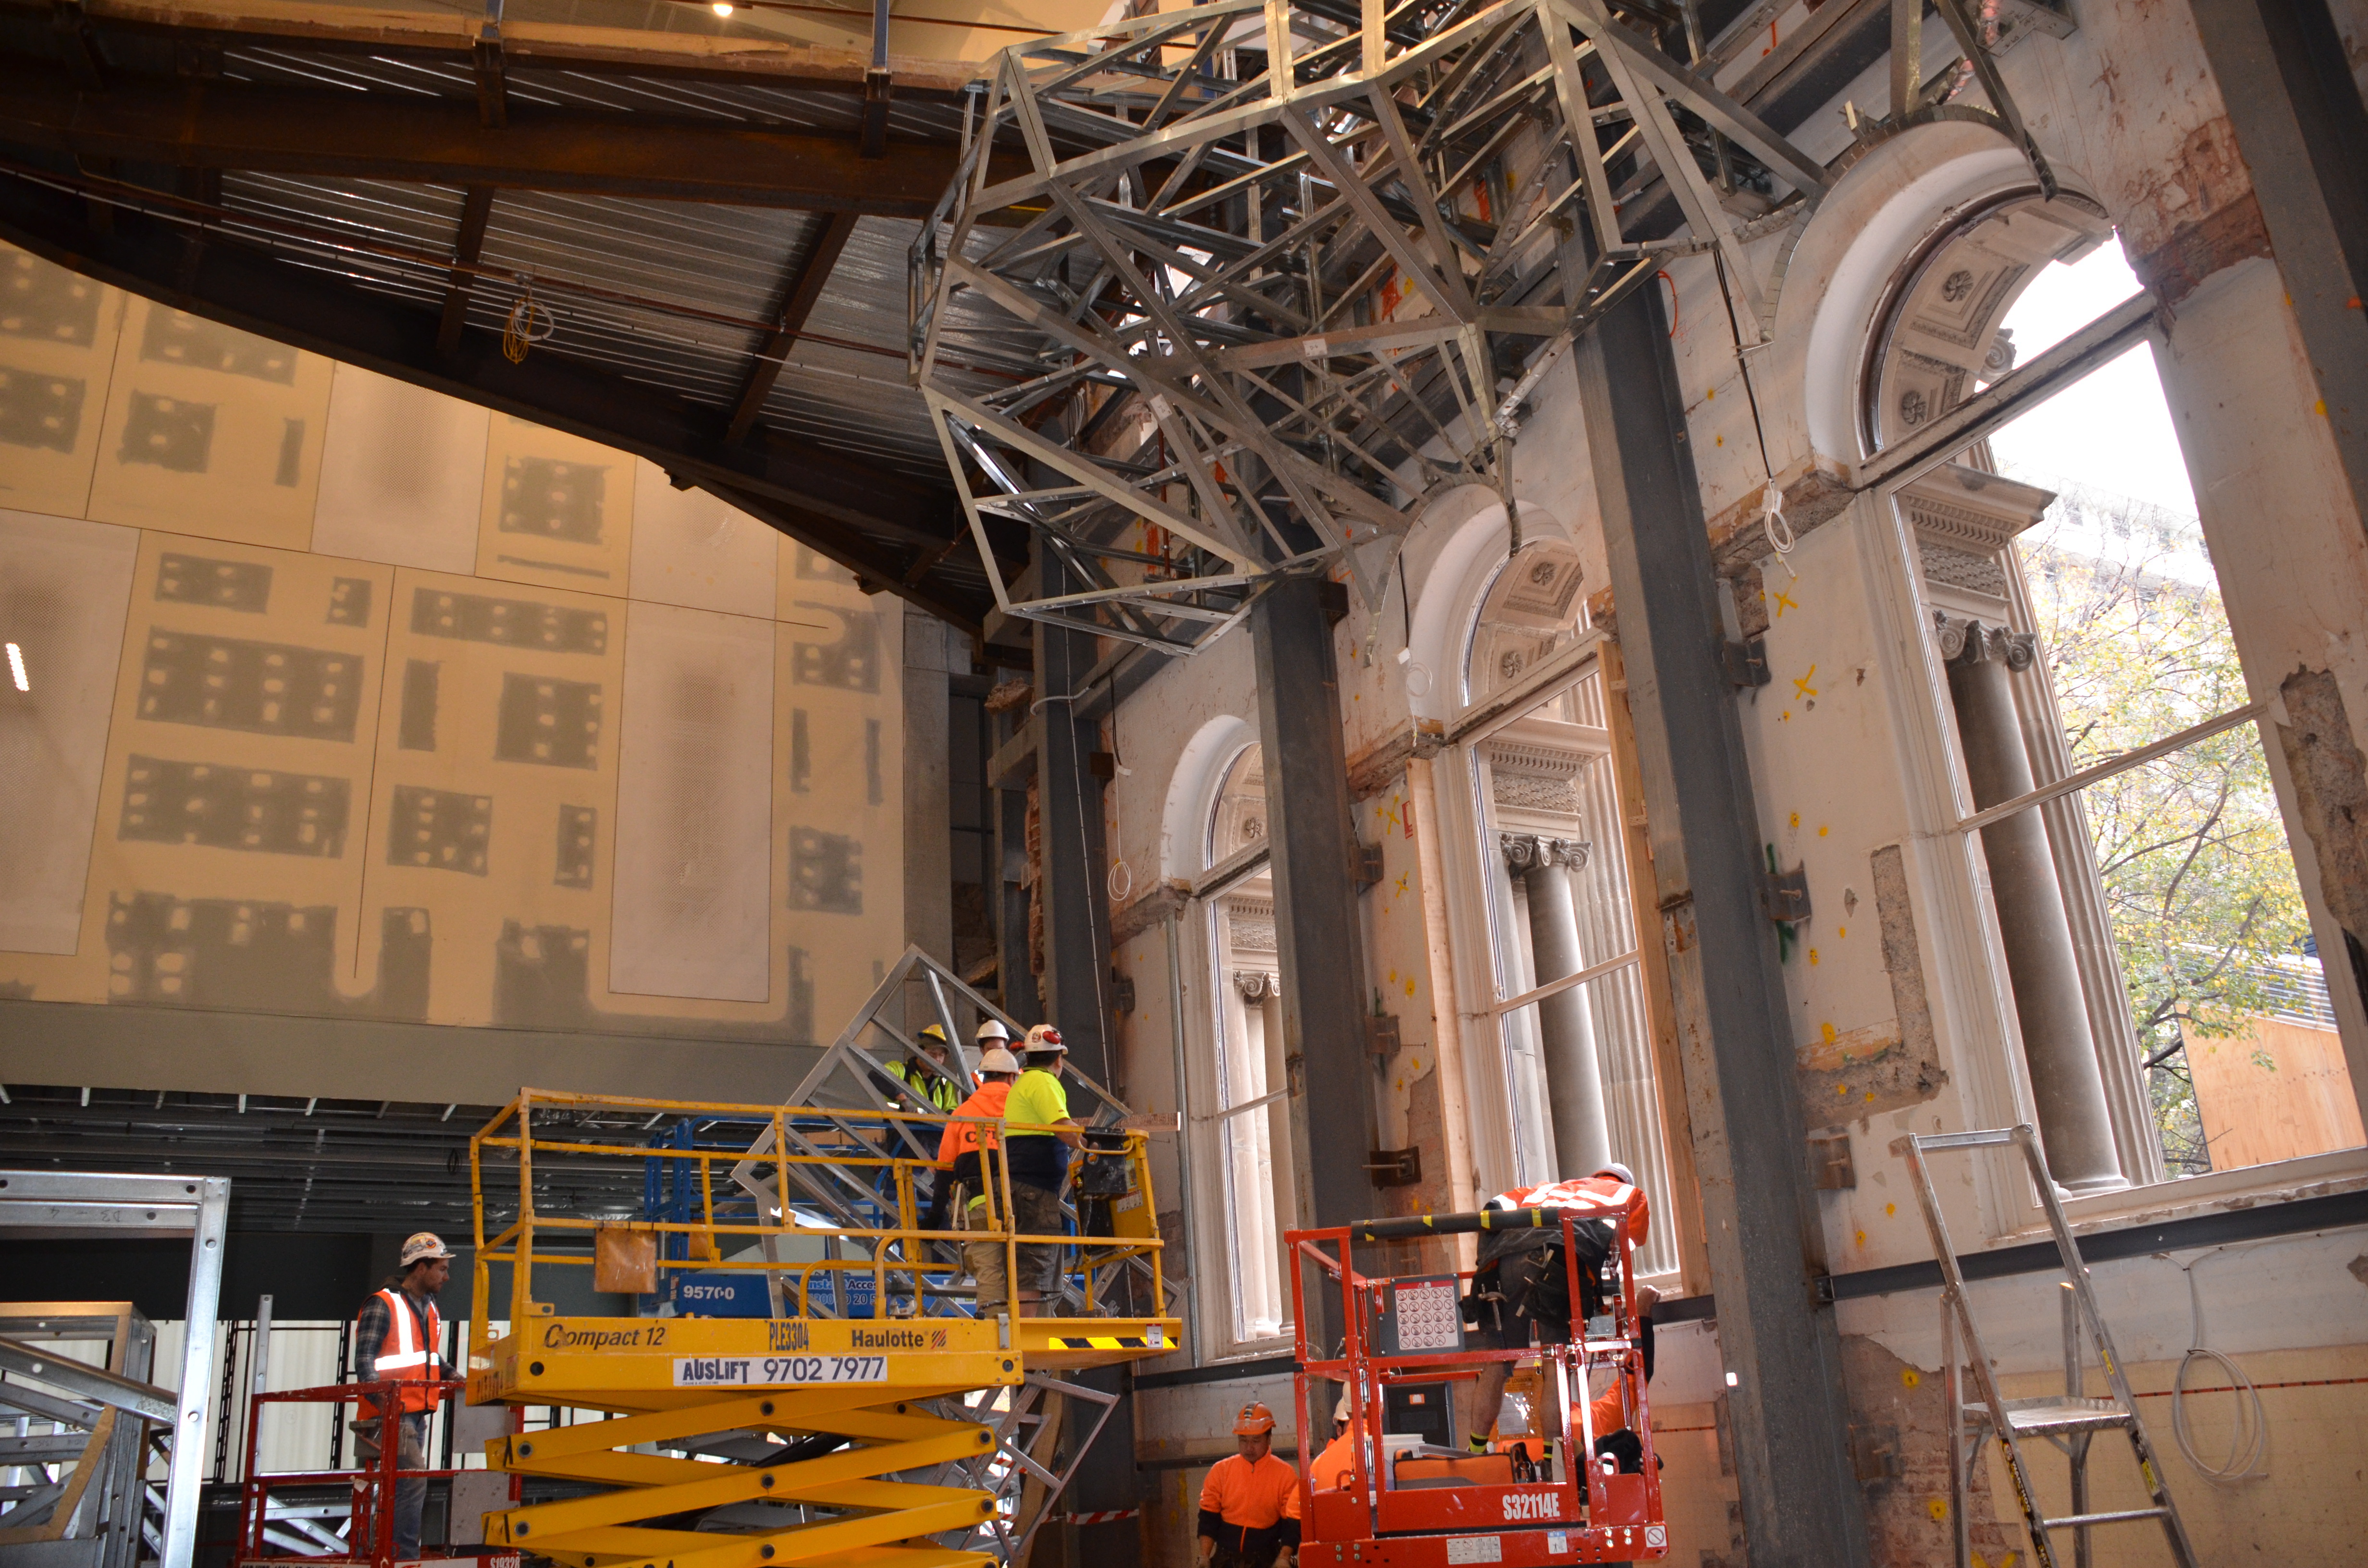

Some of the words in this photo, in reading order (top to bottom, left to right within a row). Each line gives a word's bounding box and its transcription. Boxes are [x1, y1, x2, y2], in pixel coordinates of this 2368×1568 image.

[544, 1324, 640, 1350] Compact
[647, 1327, 666, 1346] 12
[769, 1322, 809, 1351] PLE3304
[851, 1330, 924, 1347] Haulotte
[683, 1359, 750, 1384] AUSLIFT
[764, 1358, 822, 1382] 9702
[830, 1357, 884, 1380] 7977
[1502, 1492, 1560, 1520] S32114E
